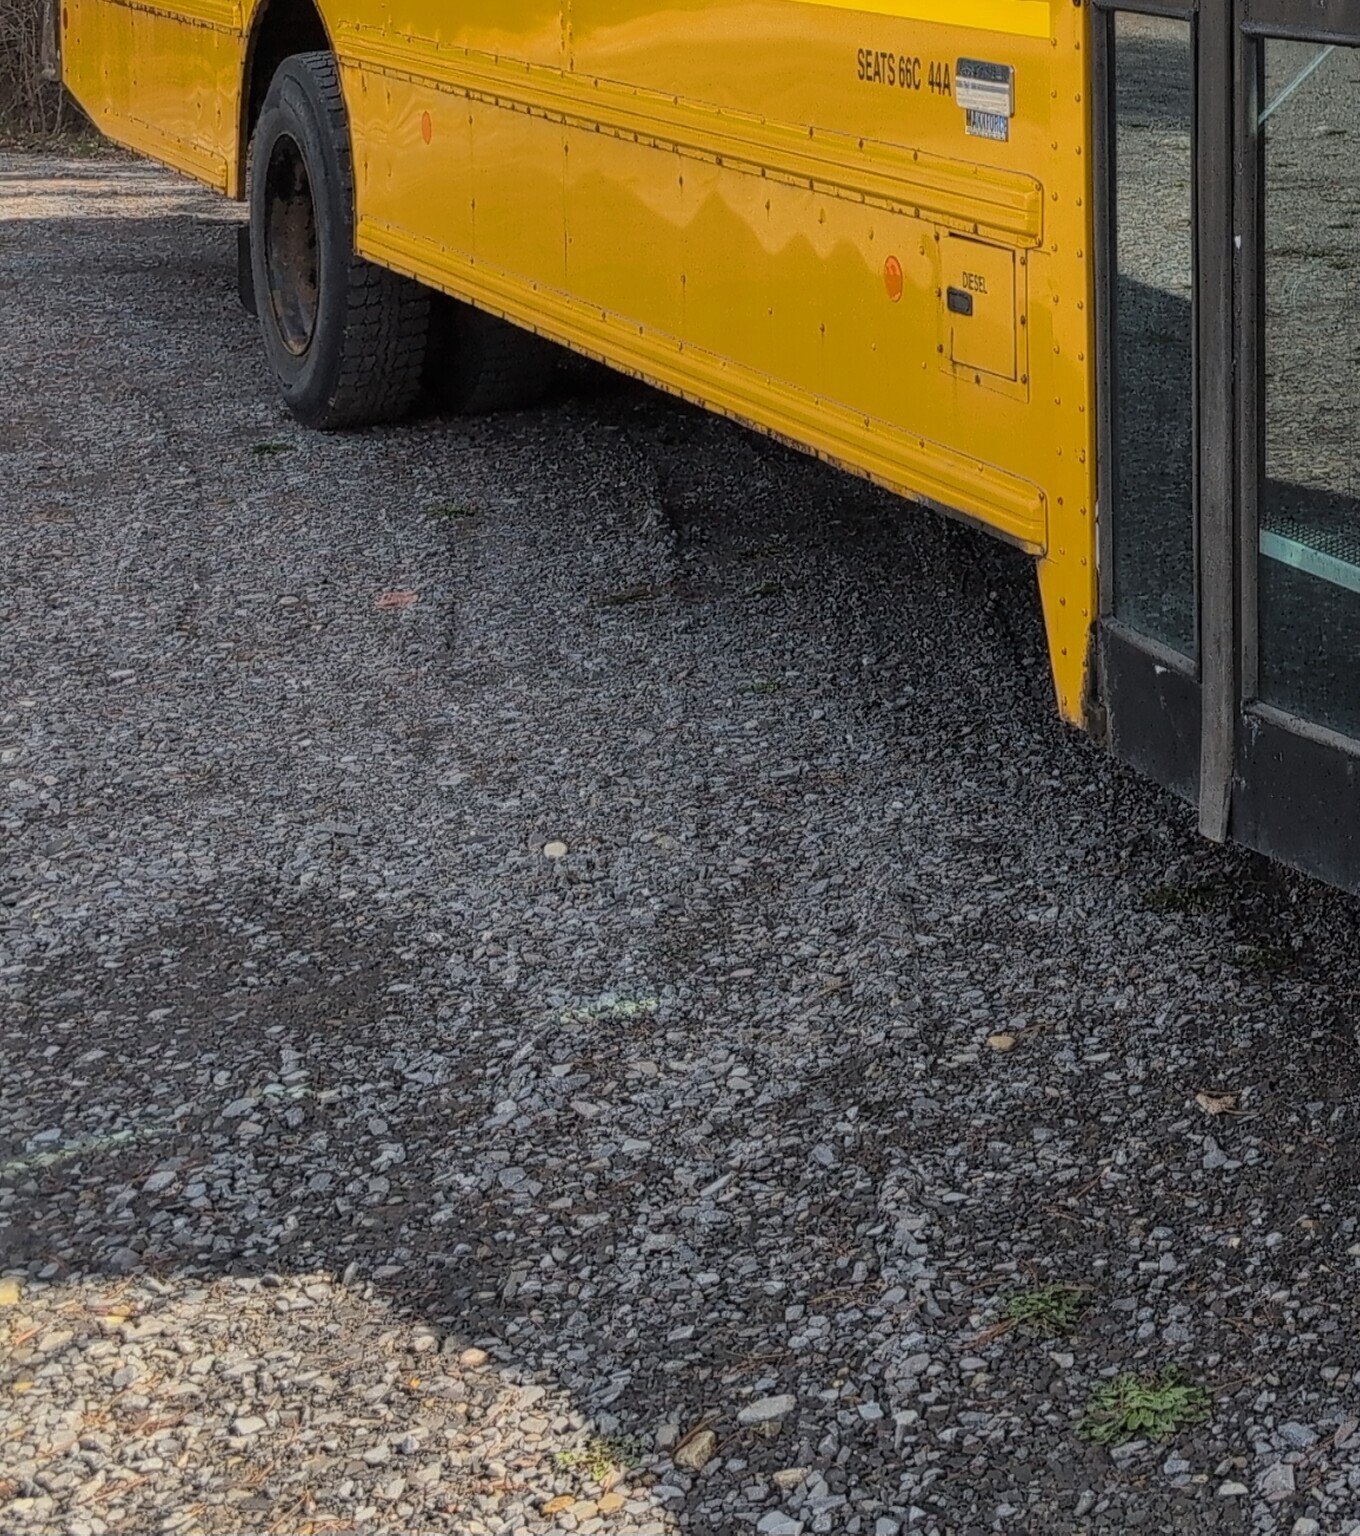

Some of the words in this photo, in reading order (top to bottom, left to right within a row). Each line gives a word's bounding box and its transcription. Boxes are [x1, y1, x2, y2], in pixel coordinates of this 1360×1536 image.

[857, 48, 896, 86] SEATS
[898, 55, 922, 90] 66C
[928, 60, 952, 96] 44A
[962, 271, 988, 295] DIESEL
